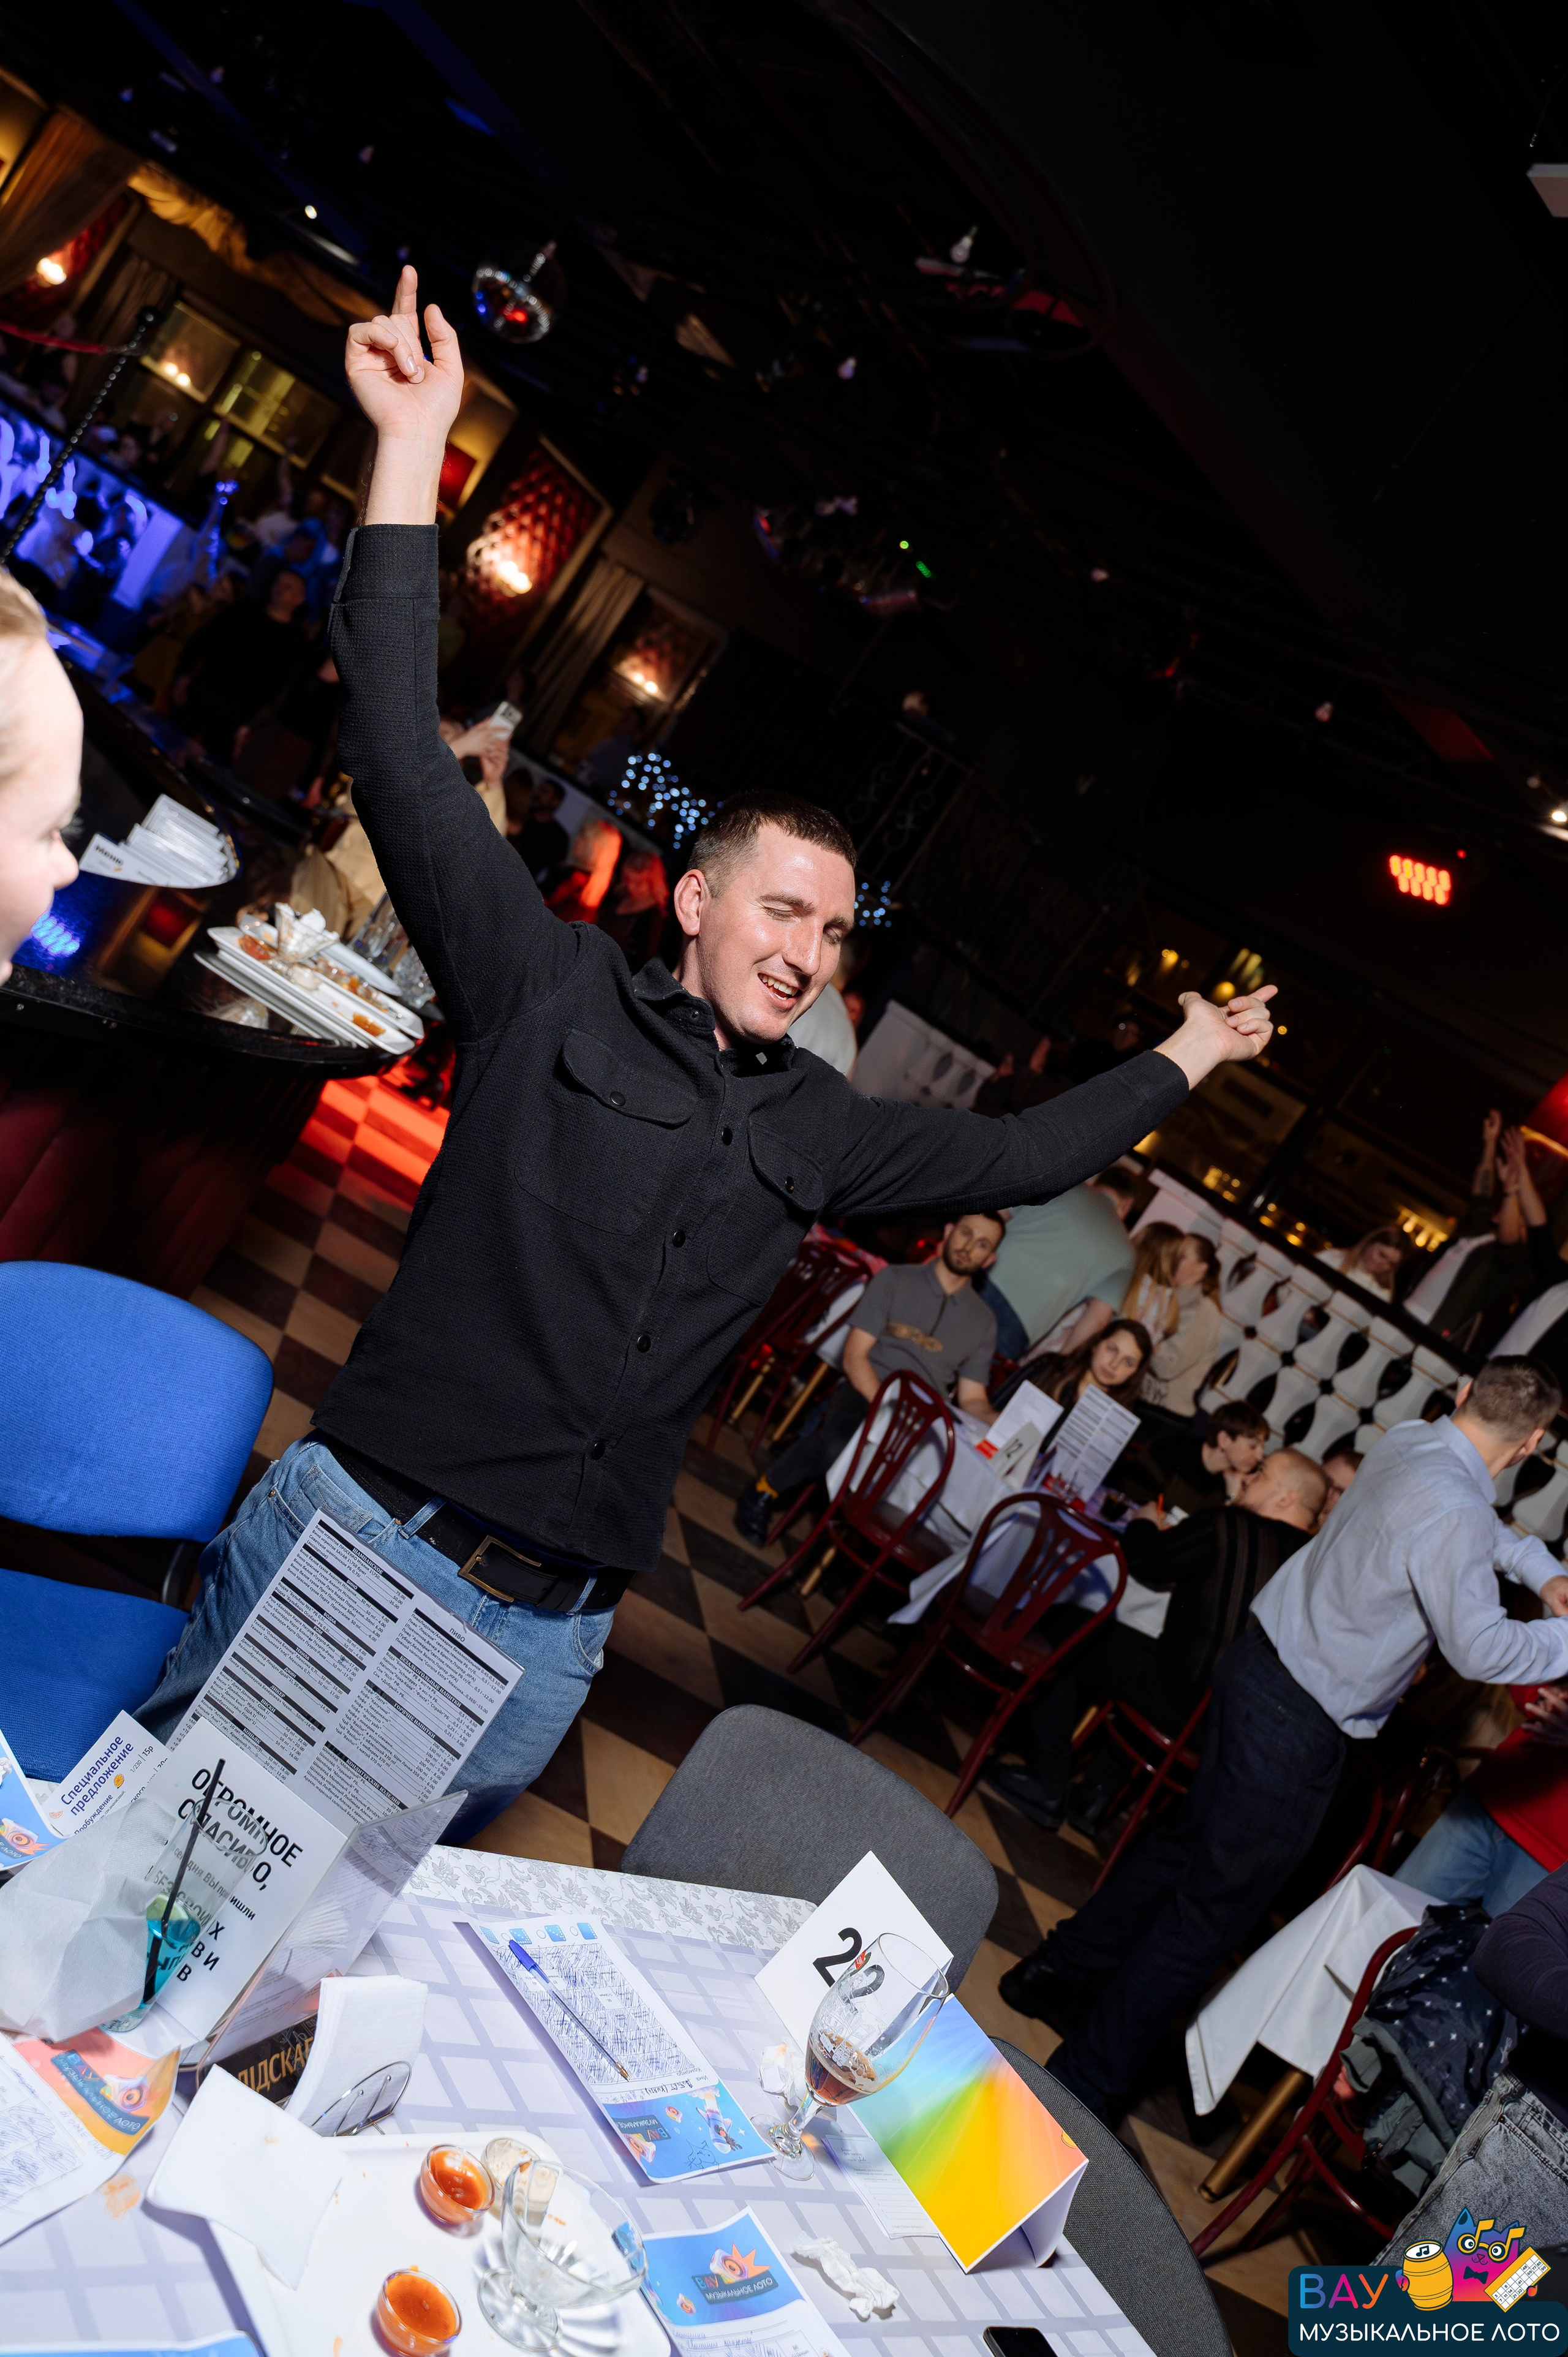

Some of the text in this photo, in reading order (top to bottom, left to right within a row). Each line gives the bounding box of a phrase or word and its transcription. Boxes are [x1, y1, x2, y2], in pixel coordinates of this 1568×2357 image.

[352, 1547, 383, 1575] ШАМПАНСКОЕ
[346, 1579, 358, 1590] ВИНО
[323, 1612, 336, 1624] ВОДКА
[313, 1625, 323, 1635] РОМ
[449, 1627, 465, 1643] ПИВО
[295, 1646, 310, 1661] ТЕКИЛА
[284, 1666, 296, 1678] ДЖИН
[399, 1654, 461, 1708] БЕЗАЛКОГОЛЬНЫЕ НАПИТКИ
[270, 1684, 285, 1699] ЛИКЕР
[260, 1699, 276, 1713] ВИСКИ
[393, 1703, 435, 1739] ГОРЯЧИЕ НАПИТКИ
[243, 1727, 262, 1744] КОНЬЯК
[130, 1759, 142, 1773] 1/230
[141, 1744, 154, 1757] 15р
[61, 1736, 124, 1806] Специальное
[70, 1742, 134, 1816] предложение
[345, 1759, 400, 1806] КОНДИТЕРСКИЕ ИЗДЕЛИЯ
[202, 1872, 220, 1890] ВЫ
[676, 2067, 701, 2076] Команда
[114, 2114, 141, 2131] ЛОТО
[646, 2127, 667, 2140] ВАУ
[695, 2274, 718, 2290] ВАУ
[705, 2277, 772, 2300] МУЗЫКАЛЬНОЕ ЛОТО
